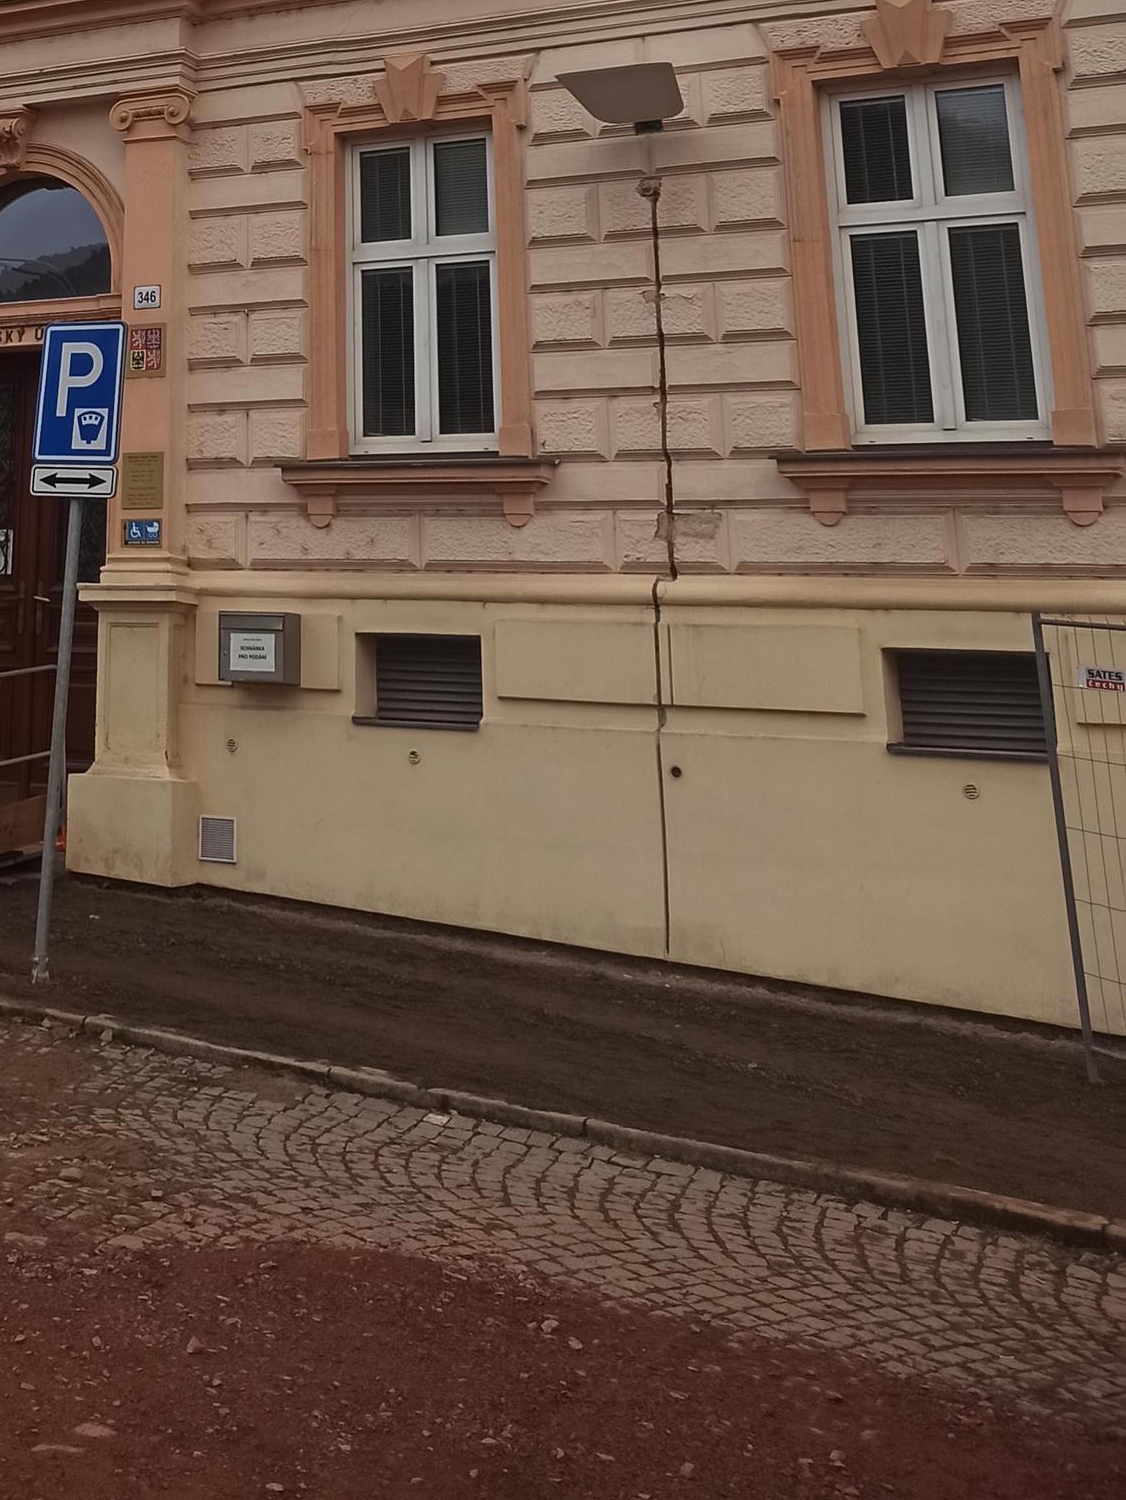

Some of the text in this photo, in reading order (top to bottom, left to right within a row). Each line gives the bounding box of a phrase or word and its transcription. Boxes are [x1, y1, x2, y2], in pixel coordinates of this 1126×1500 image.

[137, 290, 157, 304] 346
[56, 341, 104, 417] P
[1087, 669, 1123, 681] SATES
